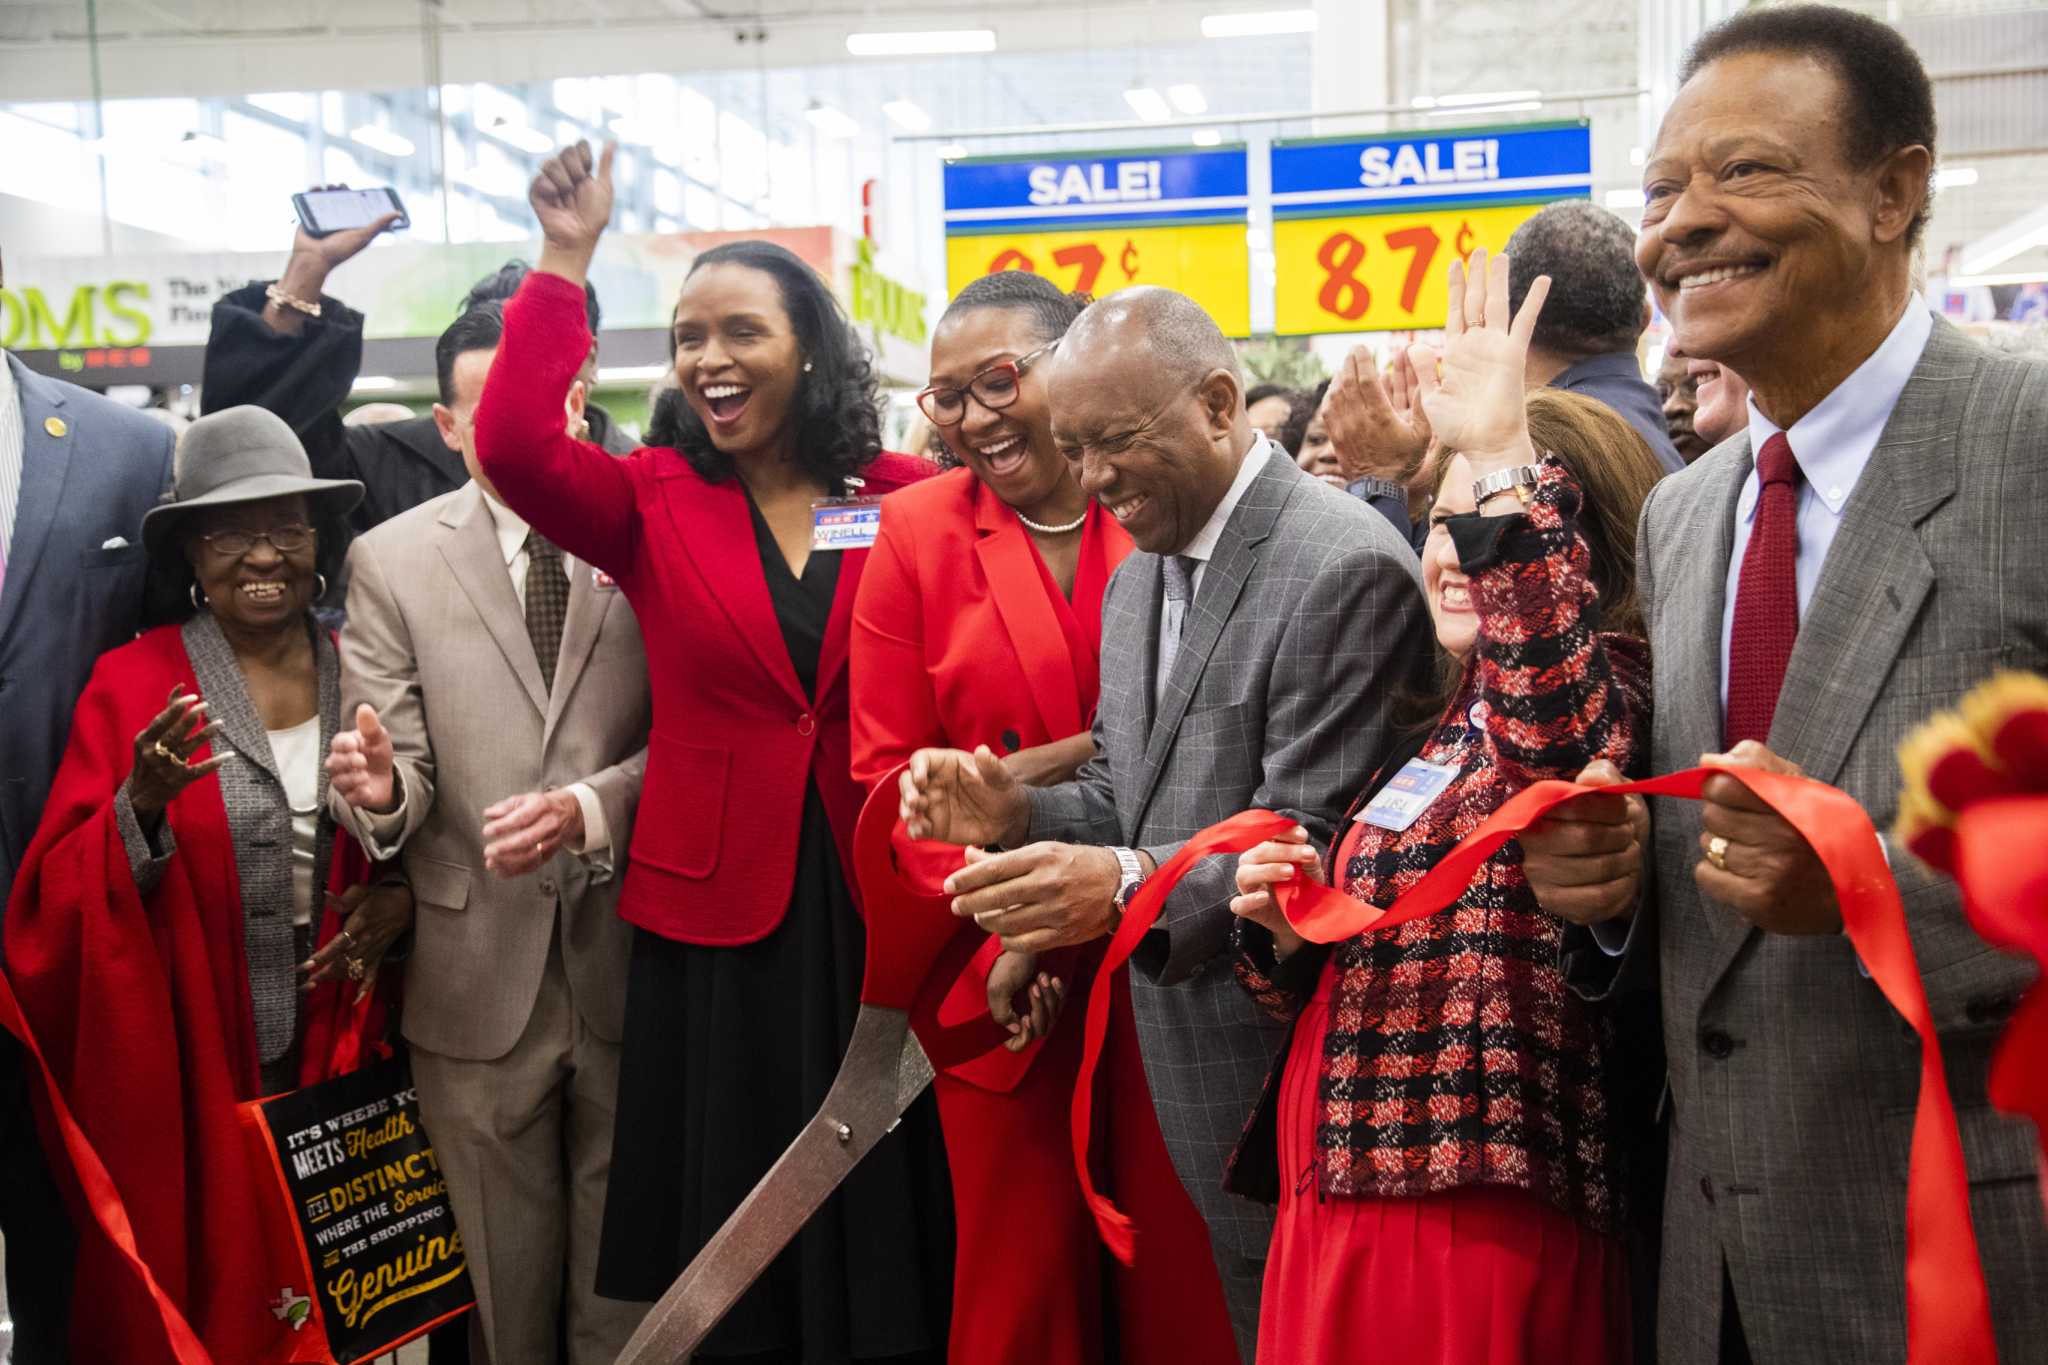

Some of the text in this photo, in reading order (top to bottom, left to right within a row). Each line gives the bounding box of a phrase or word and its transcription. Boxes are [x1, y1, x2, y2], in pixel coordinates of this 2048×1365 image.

[1028, 160, 1162, 205] SALE!
[1360, 139, 1499, 187] SALE!
[989, 239, 1139, 293] 7¢
[286, 1124, 323, 1149] IT'S
[325, 1098, 390, 1132] WHERE
[292, 1110, 415, 1180] MEETS Health
[315, 1214, 362, 1246] WHERE
[361, 1202, 390, 1225] THE
[341, 1205, 444, 1258] THE SHOPPING
